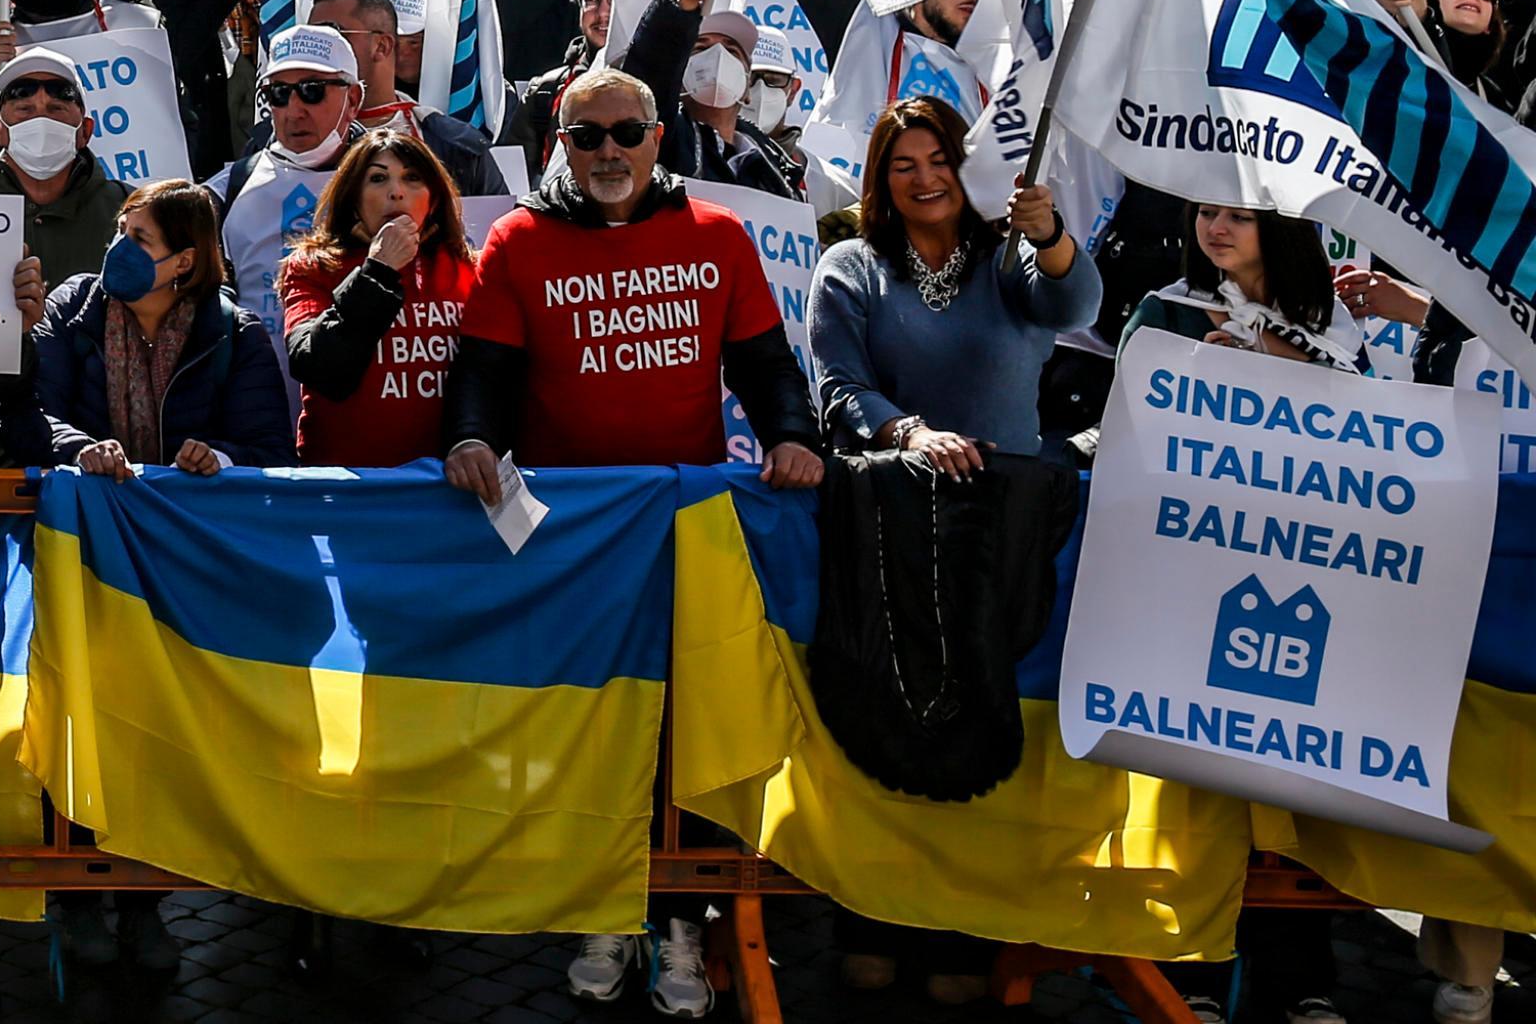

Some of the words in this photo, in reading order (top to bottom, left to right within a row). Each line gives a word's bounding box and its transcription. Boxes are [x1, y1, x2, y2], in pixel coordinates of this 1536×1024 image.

[292, 42, 331, 54] ITALIANO
[1116, 97, 1304, 165] Sindacato
[546, 273, 606, 307] NON
[612, 261, 721, 299] FAREMO
[573, 312, 581, 339] I
[590, 299, 700, 337] BAGNINI
[377, 338, 383, 364] I
[392, 335, 460, 363] BAGN
[580, 347, 607, 374] AI
[615, 336, 700, 369] CINESI
[381, 371, 408, 398] AI
[416, 370, 449, 398] CI
[1144, 368, 1445, 458] SINDACATO
[1166, 435, 1416, 515] ITALIANO
[1154, 495, 1425, 585] BALNEARI
[1225, 627, 1312, 678] SIB
[1085, 681, 1344, 770] BALNEARI
[1360, 735, 1431, 788] DA
